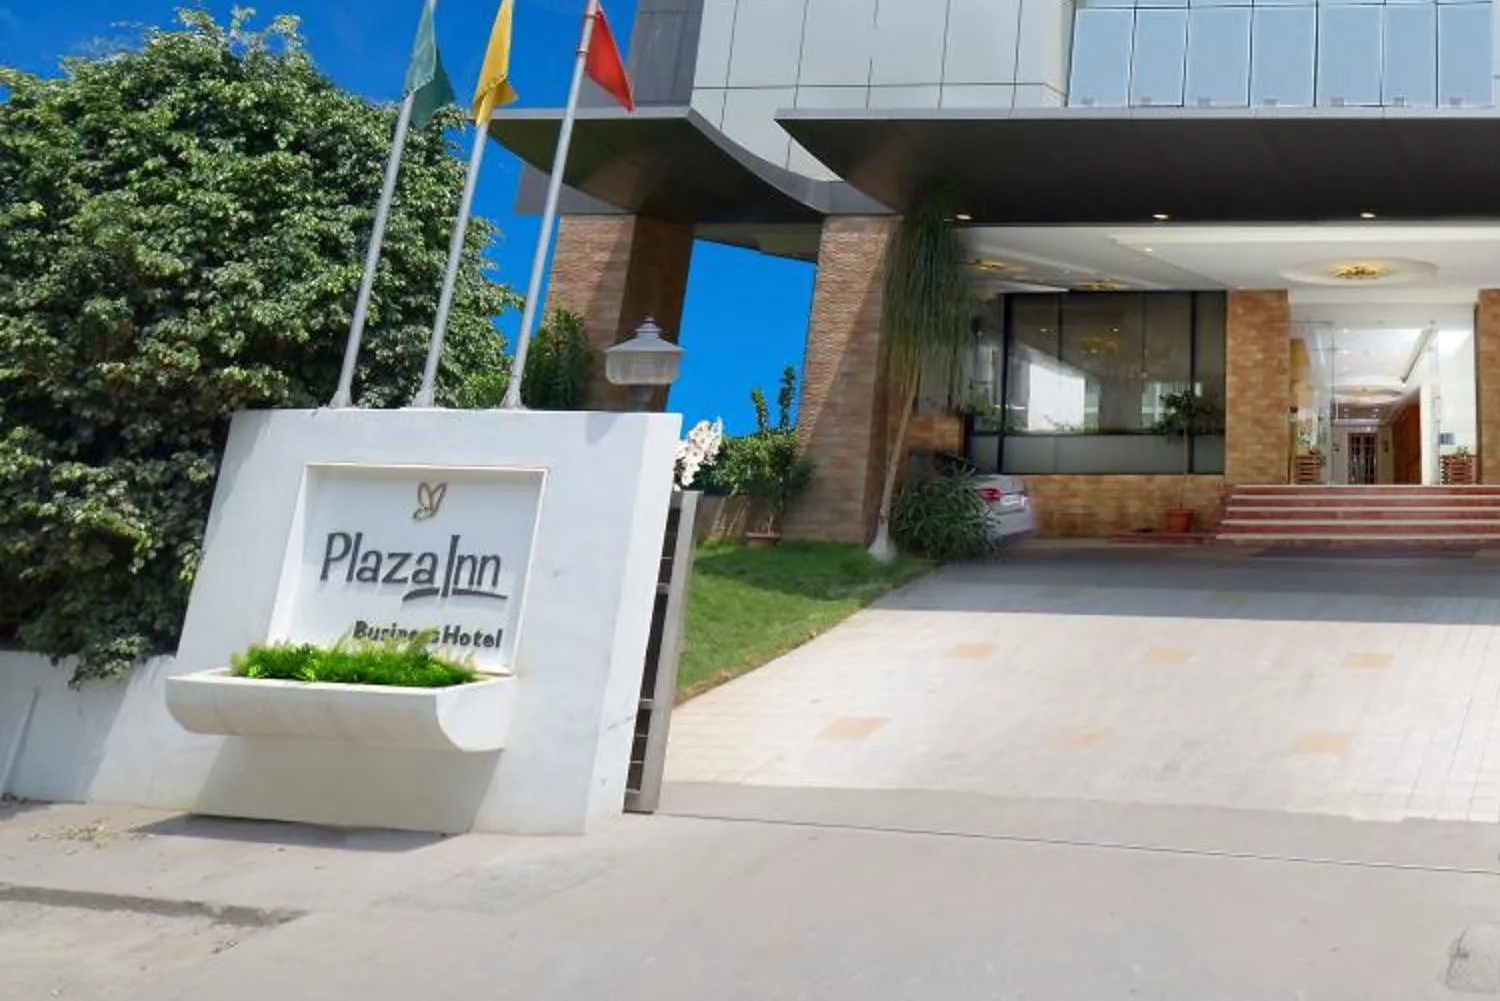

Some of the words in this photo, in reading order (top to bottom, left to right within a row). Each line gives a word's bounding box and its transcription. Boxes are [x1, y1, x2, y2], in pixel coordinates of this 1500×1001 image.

[320, 532, 438, 582] Plaza
[441, 534, 502, 598] Inn
[442, 625, 503, 648] Hotel
